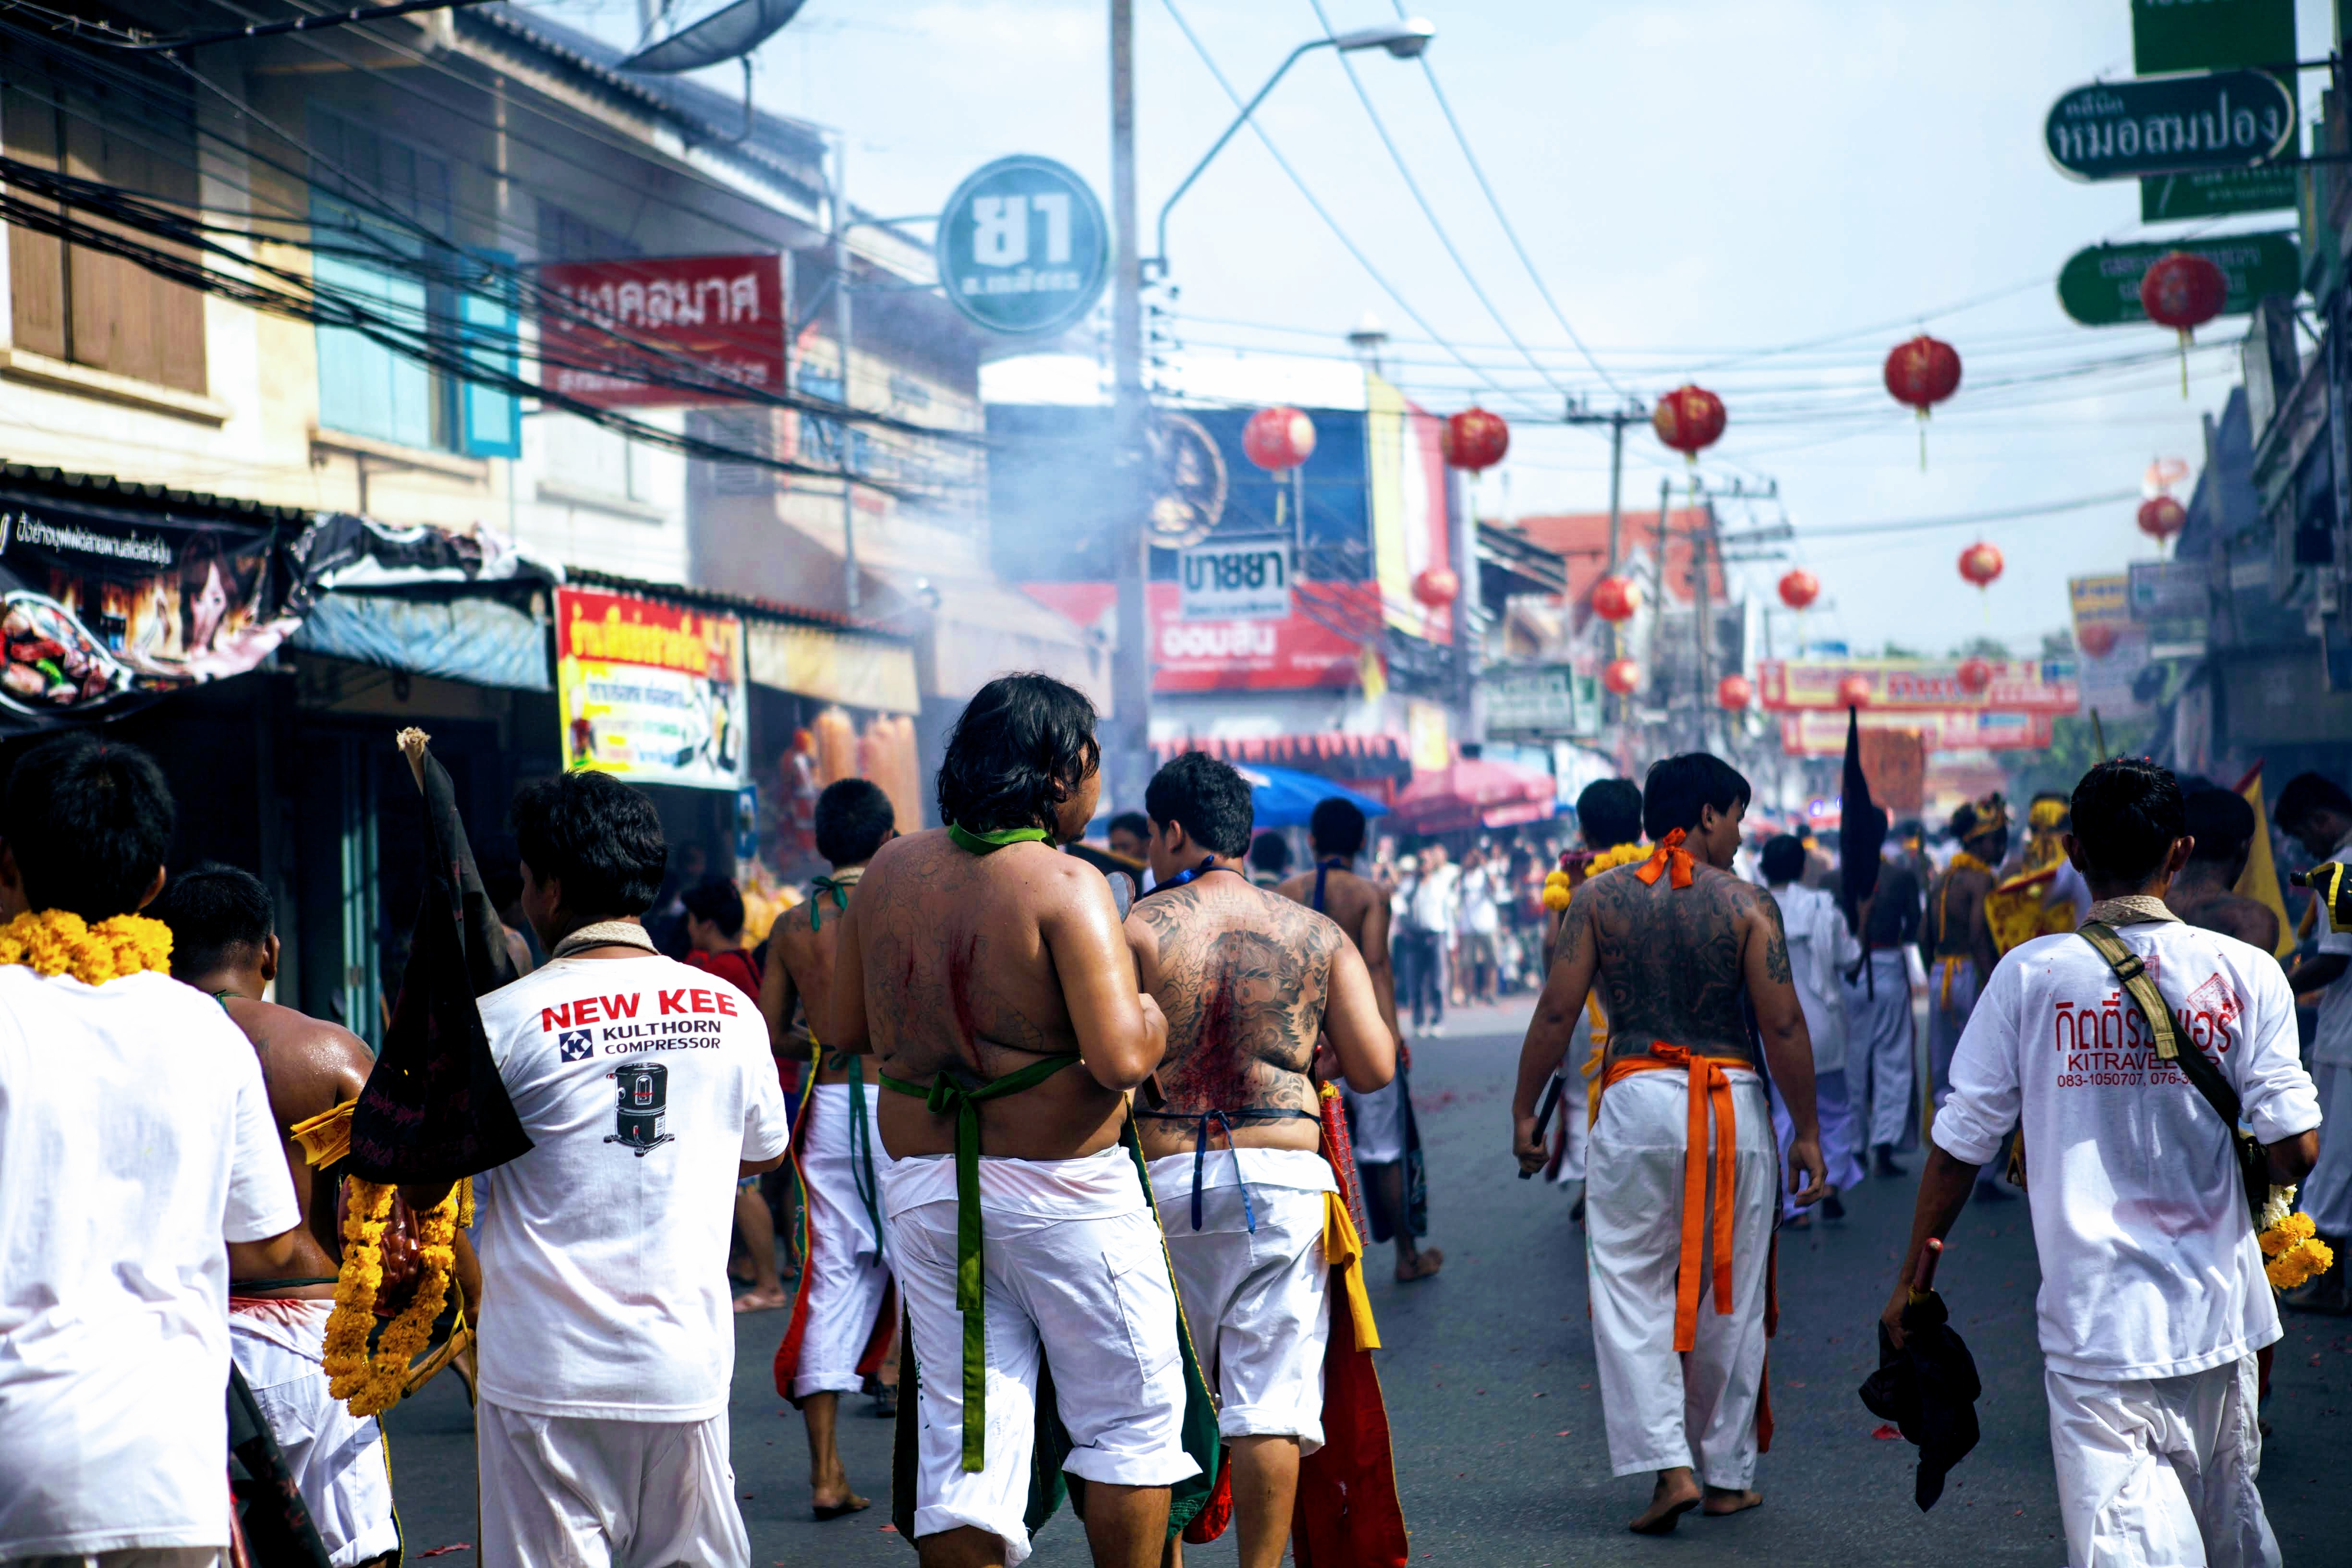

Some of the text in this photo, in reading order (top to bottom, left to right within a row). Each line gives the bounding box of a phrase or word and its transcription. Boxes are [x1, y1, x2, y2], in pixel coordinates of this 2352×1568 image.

[2054, 88, 2280, 160] หมอสมปอง
[541, 988, 738, 1033] NEW KEE
[603, 1020, 721, 1041] KULTHORN
[605, 1037, 721, 1054] COMPRESSOR
[2058, 1072, 2146, 1087] 083-1050707,
